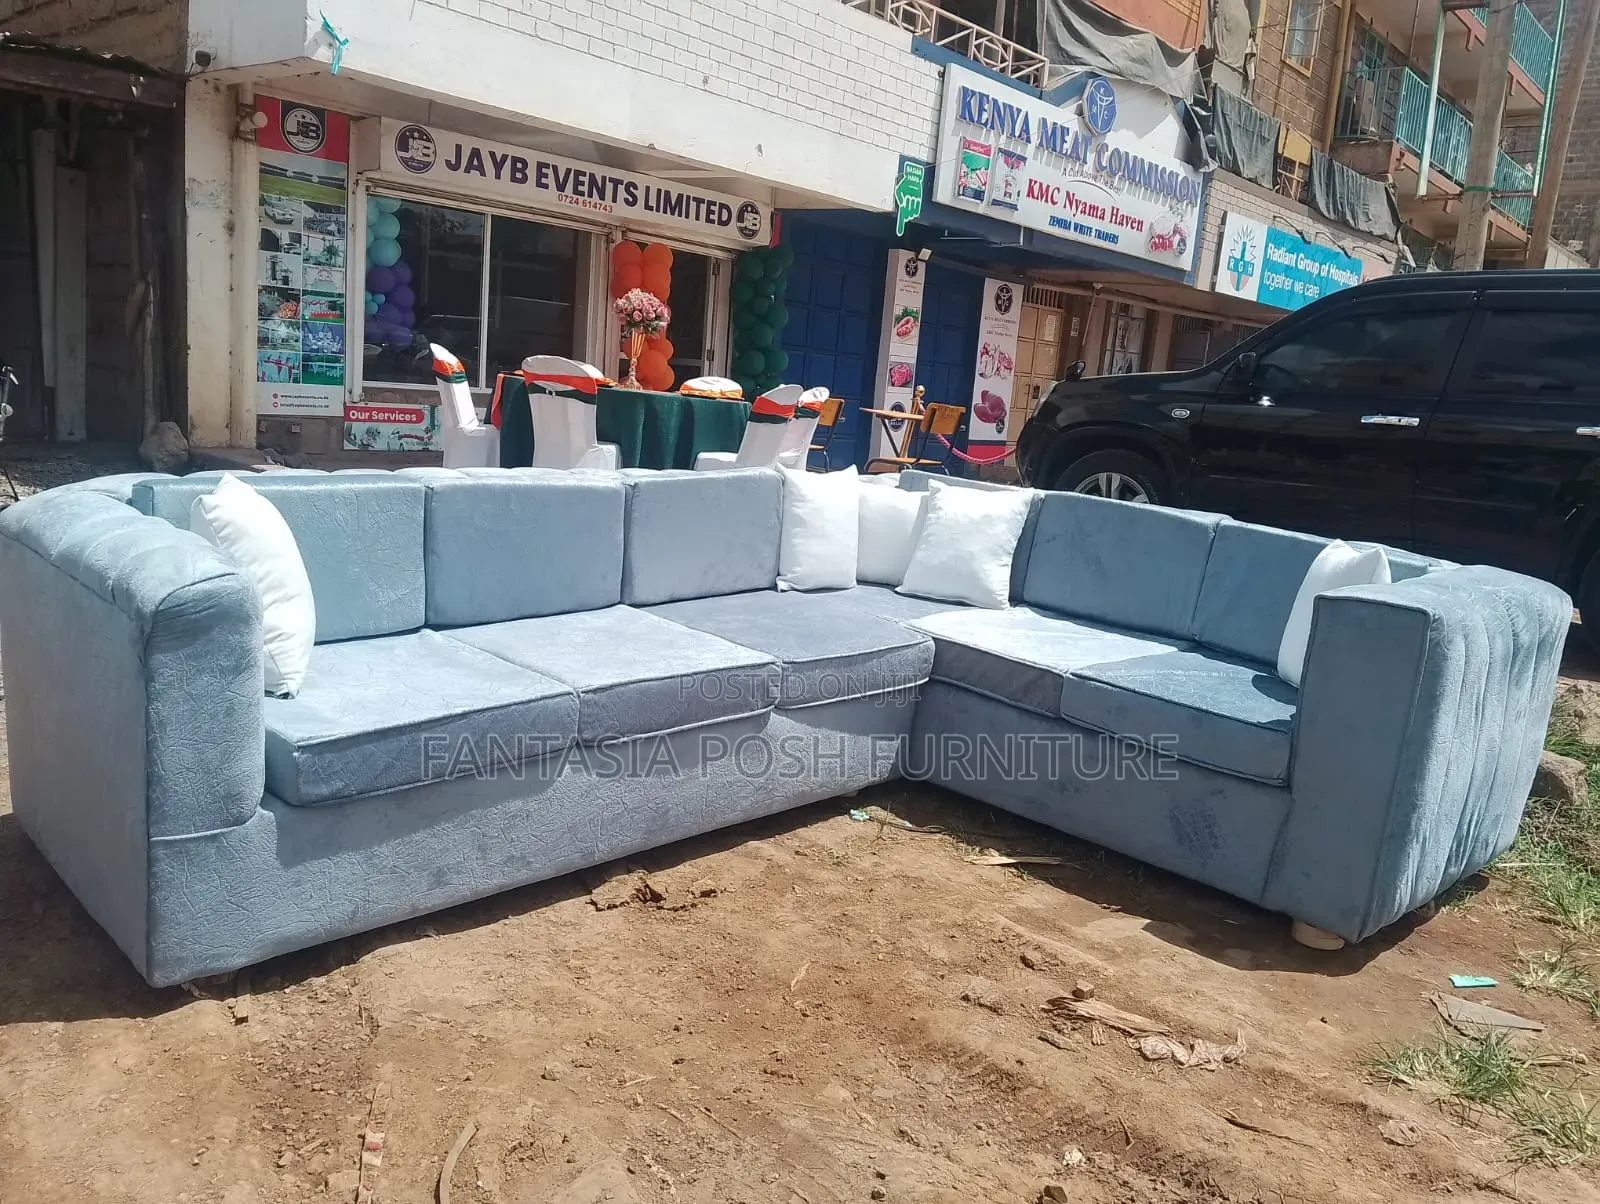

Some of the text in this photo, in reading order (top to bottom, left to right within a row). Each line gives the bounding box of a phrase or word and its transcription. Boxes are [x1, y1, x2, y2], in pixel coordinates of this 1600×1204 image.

[958, 85, 1200, 208] KENYA MEAT COMMISSION
[445, 143, 733, 227] JAYB EVENTS LIMITED
[1061, 167, 1067, 177] A
[1099, 174, 1108, 187] The
[557, 193, 613, 214] 0724 614743
[1026, 178, 1144, 233] KMC Nyama Haven
[1073, 222, 1094, 239] WHITE
[1094, 228, 1119, 245] TRADERS
[1266, 243, 1360, 286] Radiant Group of Hospitals
[1263, 270, 1320, 299] together we care
[349, 410, 417, 421] Our Services
